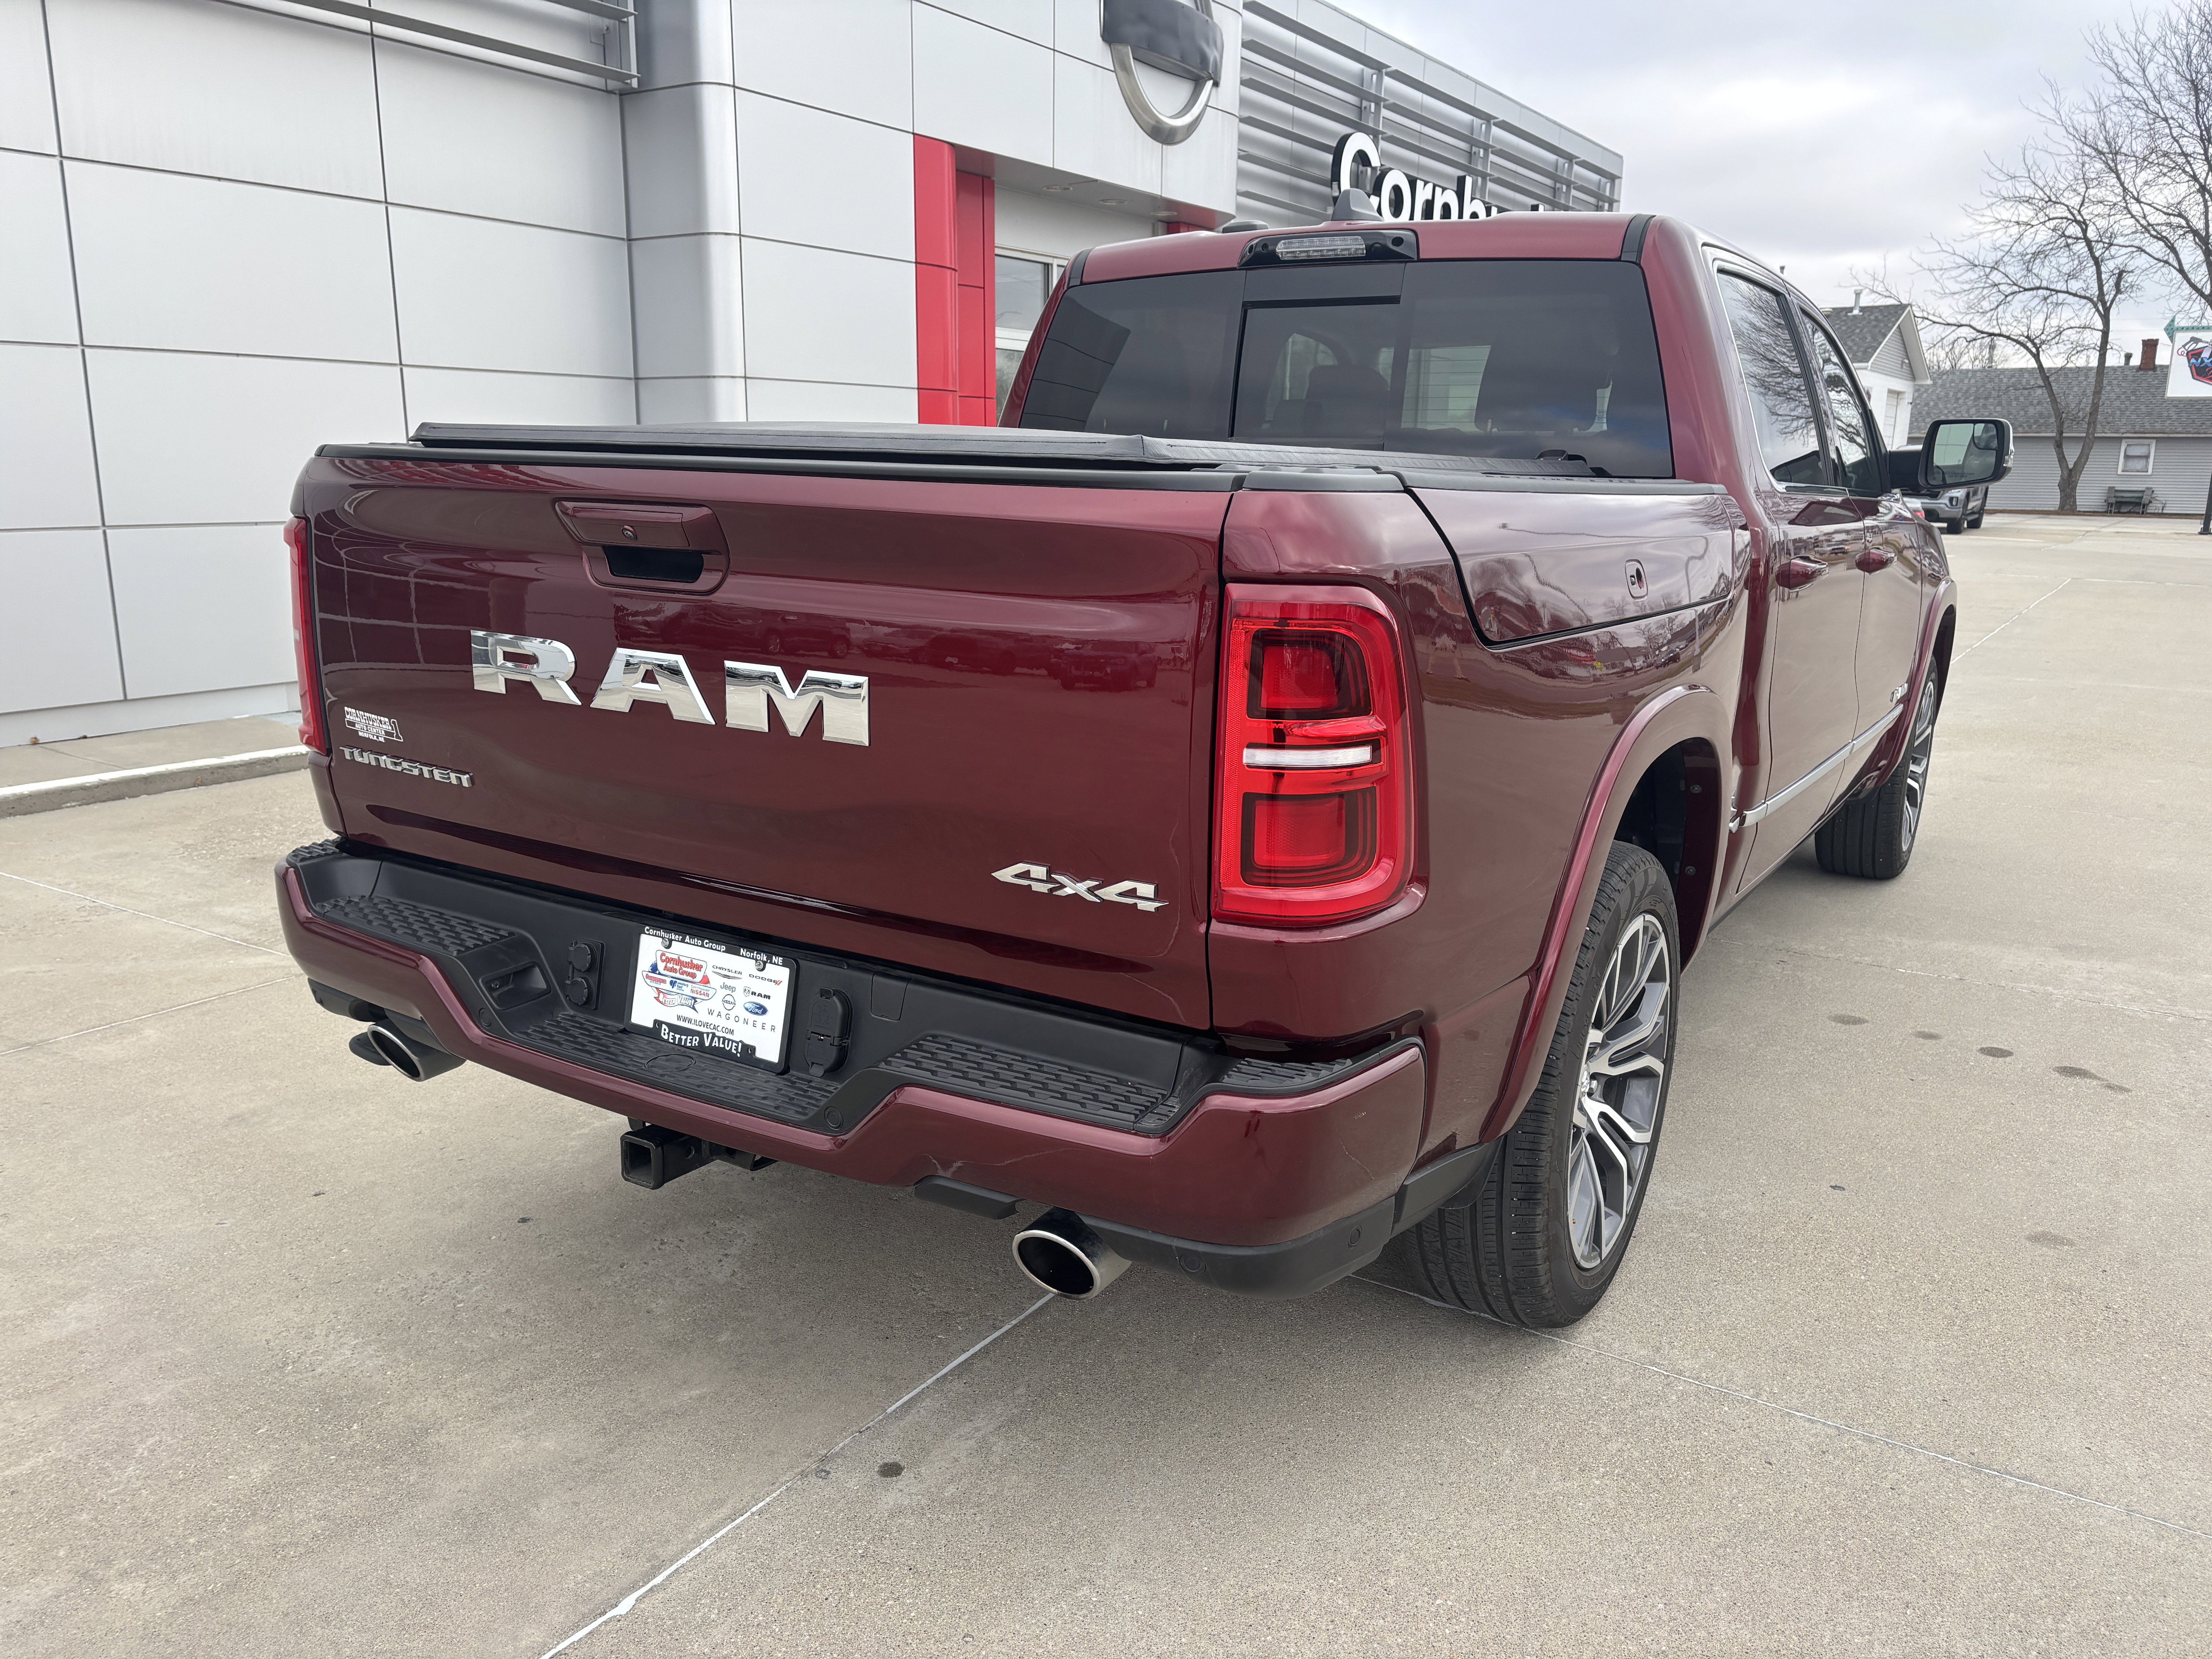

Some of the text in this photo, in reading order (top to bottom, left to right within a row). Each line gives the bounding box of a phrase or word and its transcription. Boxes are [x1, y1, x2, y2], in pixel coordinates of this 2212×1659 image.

[1331, 131, 1544, 222] Cornh
[471, 630, 870, 747] RAM
[344, 706, 392, 730] CORNHUSKER
[368, 726, 385, 735] CENTER
[339, 745, 475, 787] TUNGSTEN
[644, 926, 783, 965] Cornhusker Auto Group Norfolk, NE
[660, 952, 703, 972] Cornhusker
[663, 963, 678, 974] Auto
[678, 967, 697, 979] Group
[712, 965, 742, 975] CHRYSLER
[720, 982, 736, 993] Jeep
[749, 974, 778, 984] DODGE
[690, 988, 709, 998] NISSAN
[751, 991, 771, 1000] RAM
[748, 1003, 763, 1014] Ford
[677, 1014, 734, 1036] WWW.ILOVECAC.COM
[708, 1008, 776, 1033] WAGONEER
